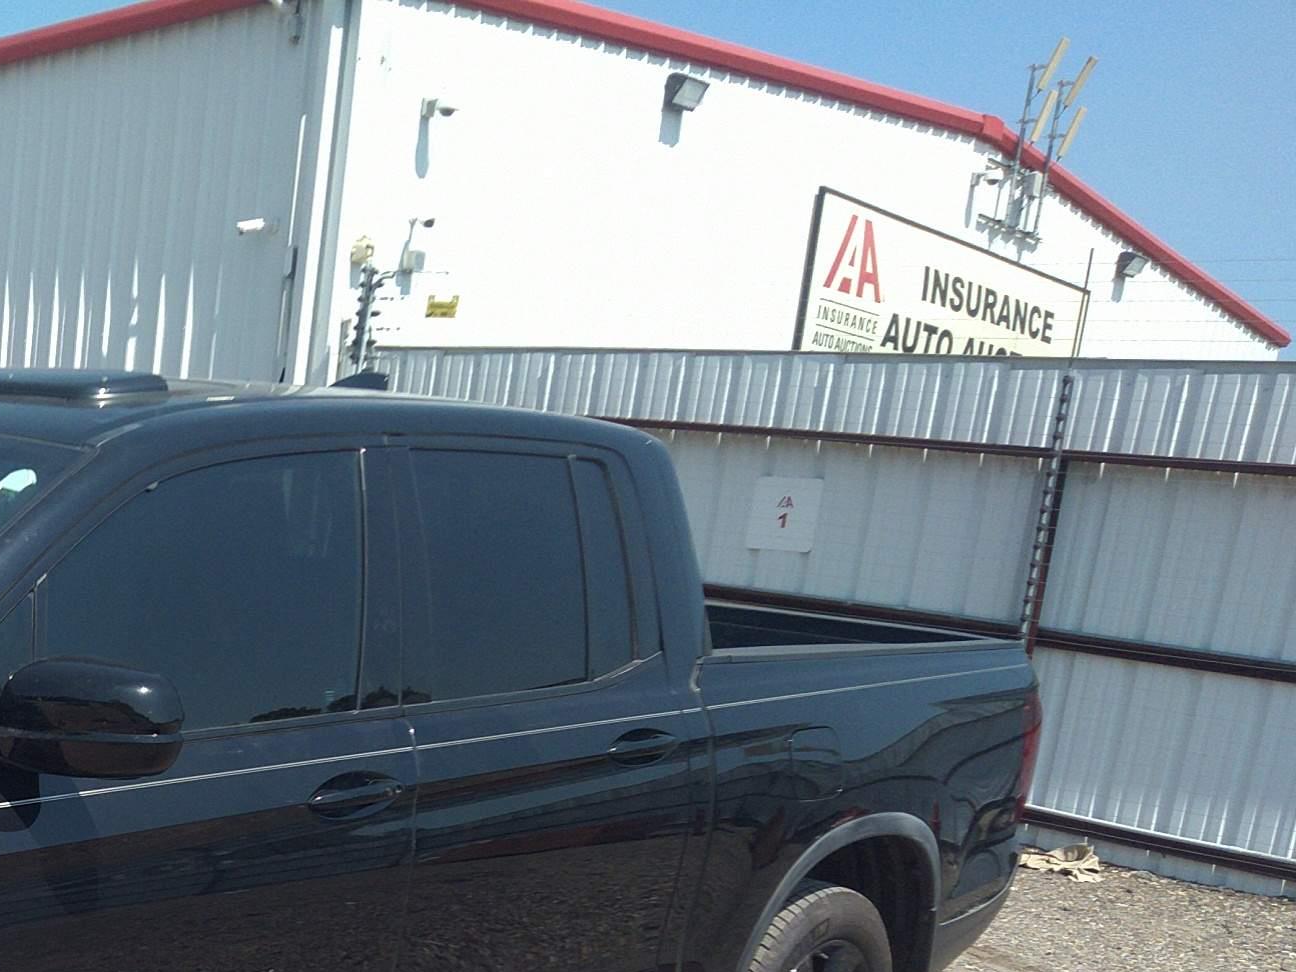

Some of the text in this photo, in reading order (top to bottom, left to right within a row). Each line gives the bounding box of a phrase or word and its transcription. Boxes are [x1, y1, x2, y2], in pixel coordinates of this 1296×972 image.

[815, 304, 879, 335] INSURANCE
[921, 265, 1056, 345] INSURANCE
[811, 330, 835, 349] AUTO
[880, 312, 954, 355] AUTO
[777, 512, 789, 528] 1
